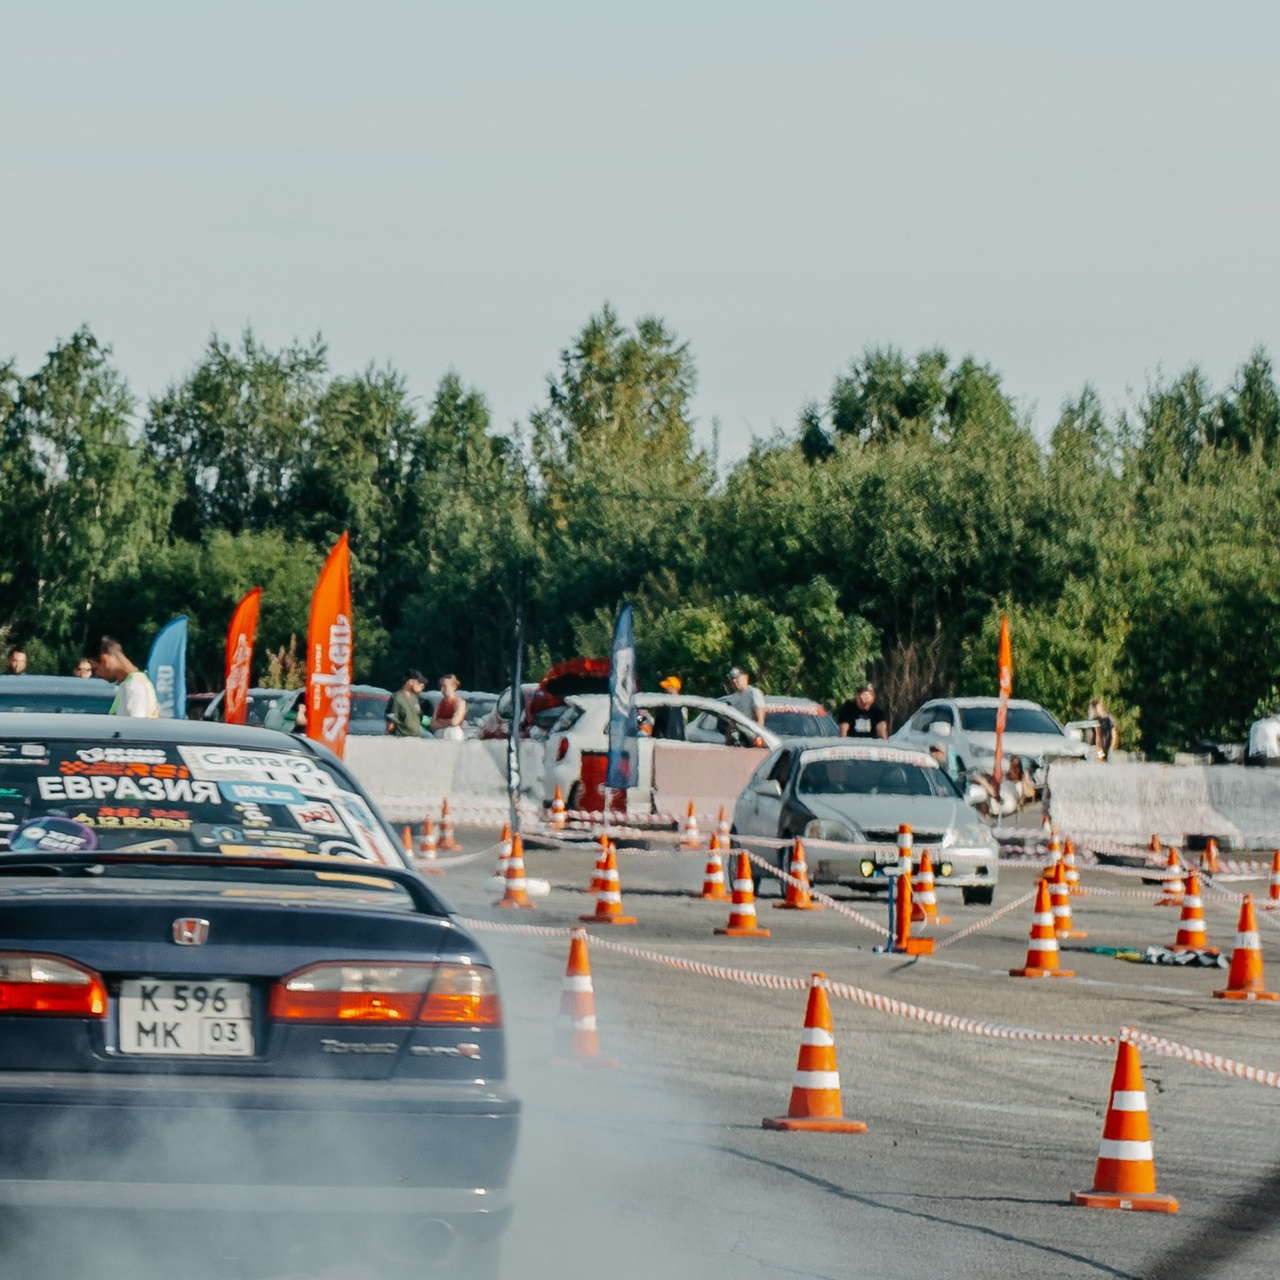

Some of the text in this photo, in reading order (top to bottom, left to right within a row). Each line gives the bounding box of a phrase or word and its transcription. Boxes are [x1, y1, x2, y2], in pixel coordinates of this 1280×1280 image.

[37, 776, 221, 804] ЕВРАЗИЯ
[173, 985, 227, 1013] 596
[211, 1022, 238, 1042] 03
